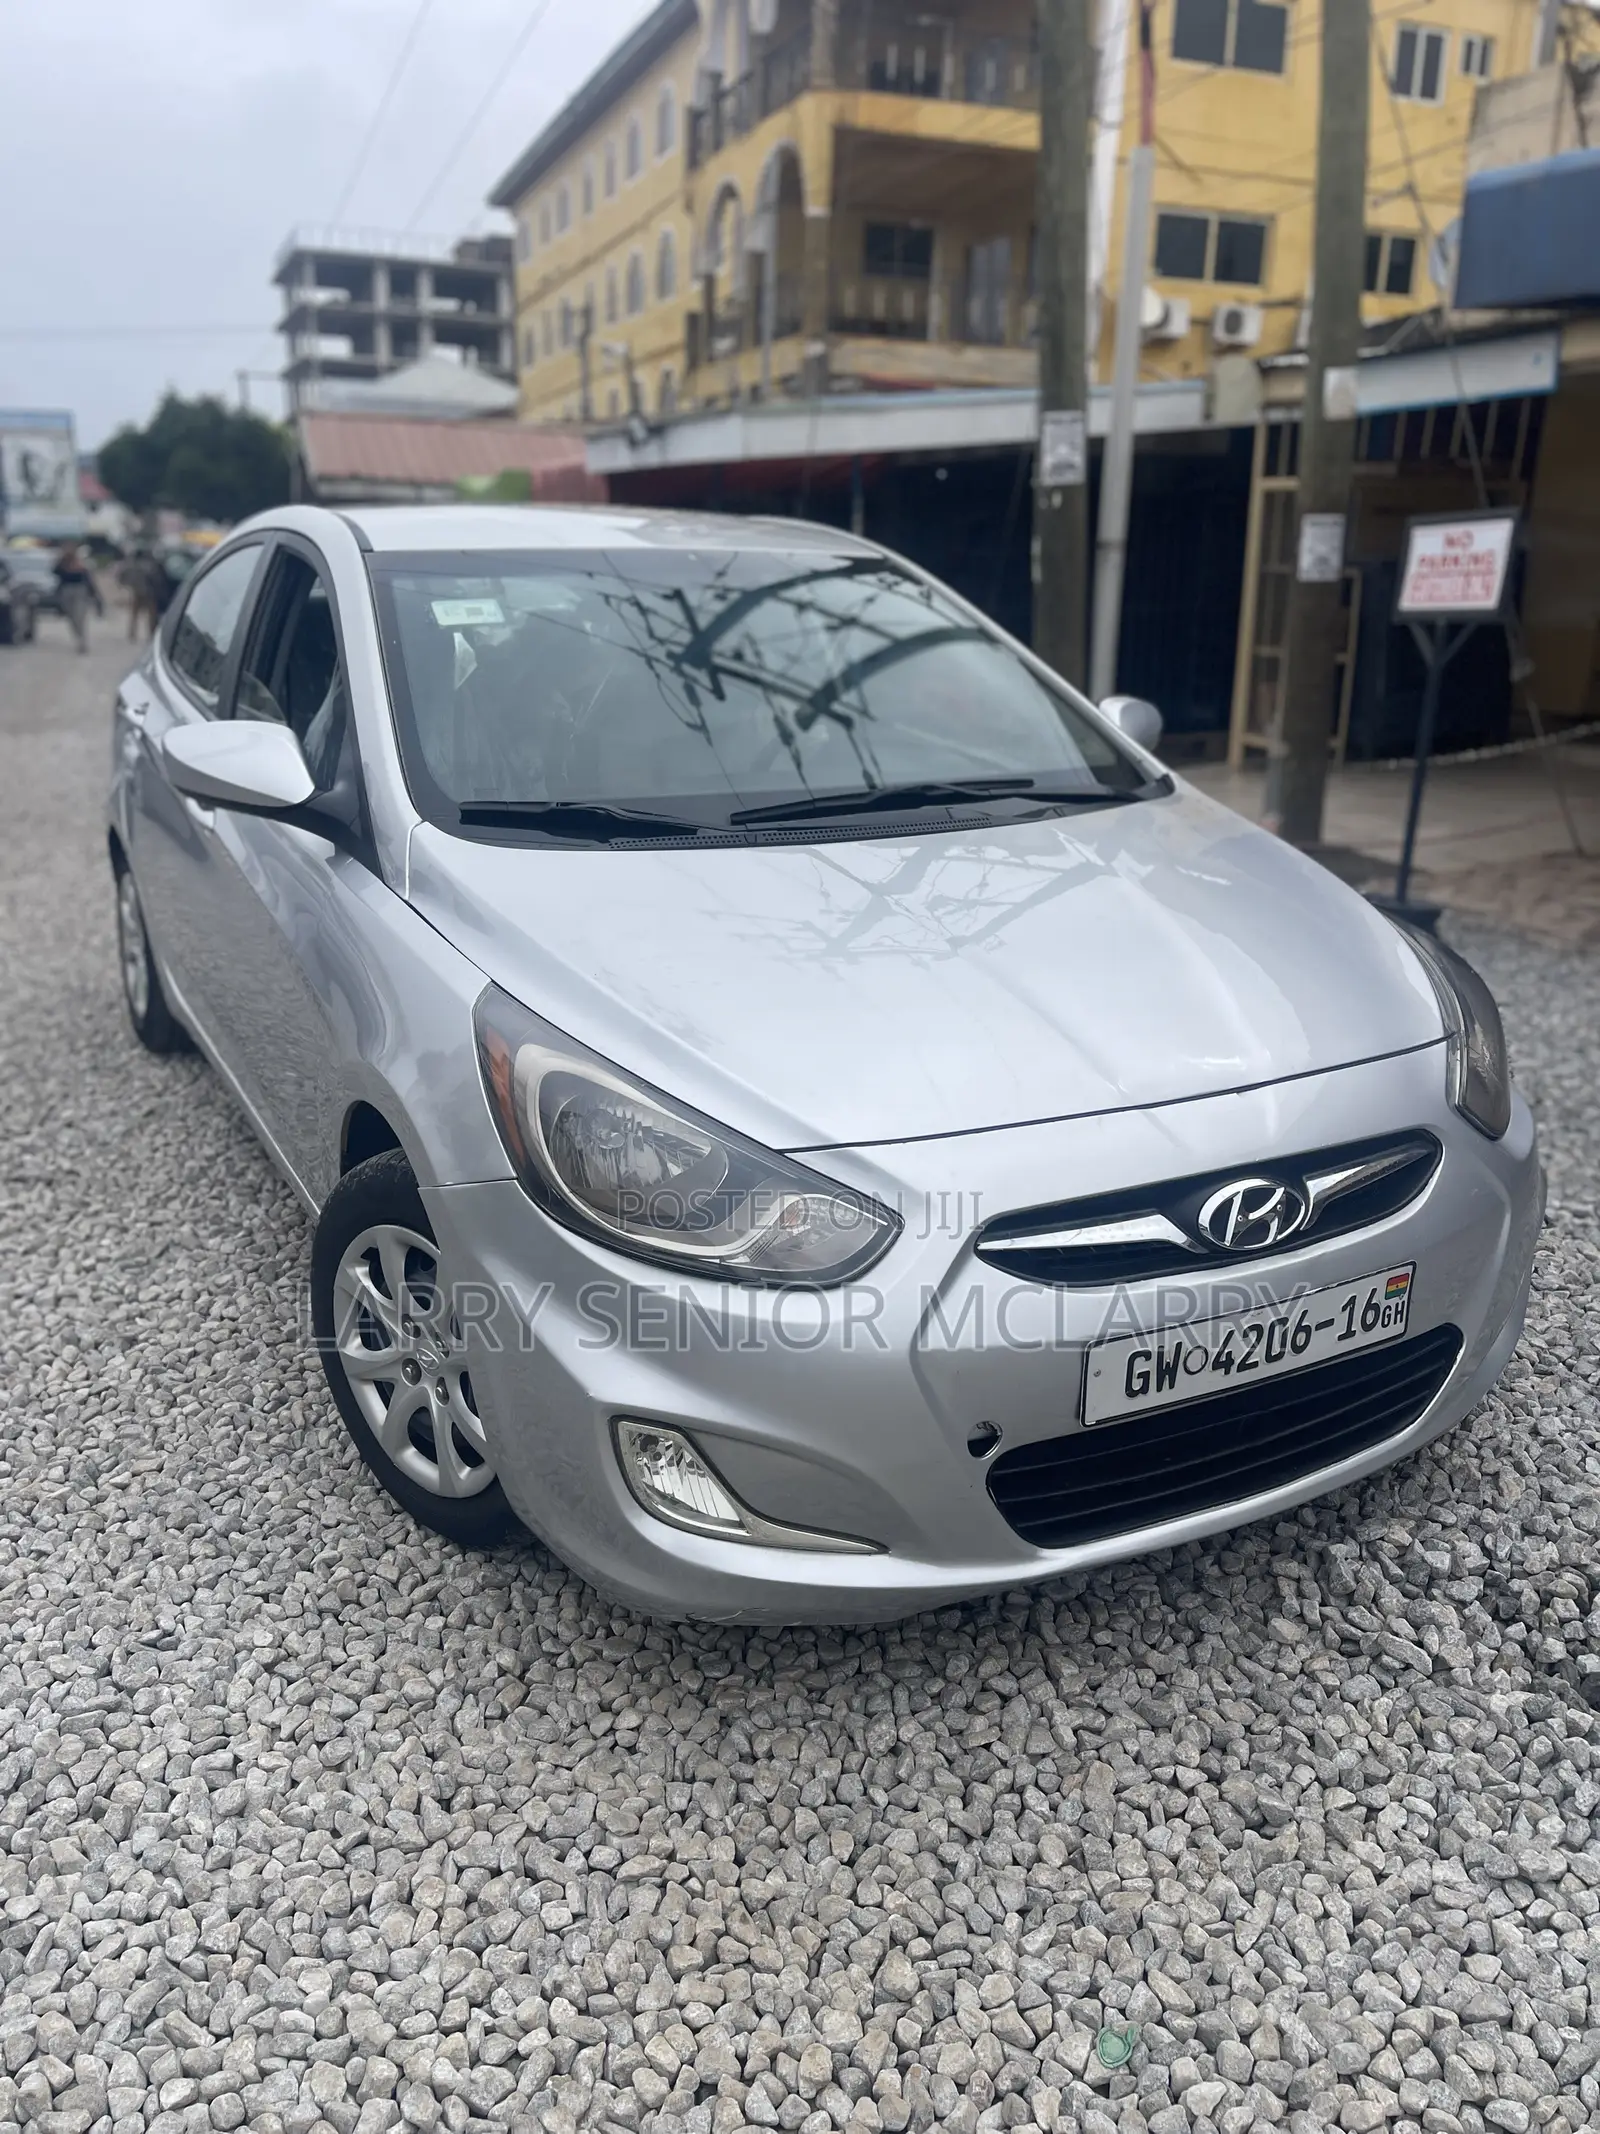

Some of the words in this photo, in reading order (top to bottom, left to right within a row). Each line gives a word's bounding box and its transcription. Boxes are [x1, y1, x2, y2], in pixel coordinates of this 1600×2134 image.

[1444, 530, 1474, 549] NO
[1125, 1340, 1183, 1398] GW
[1380, 1299, 1404, 1329] GH
